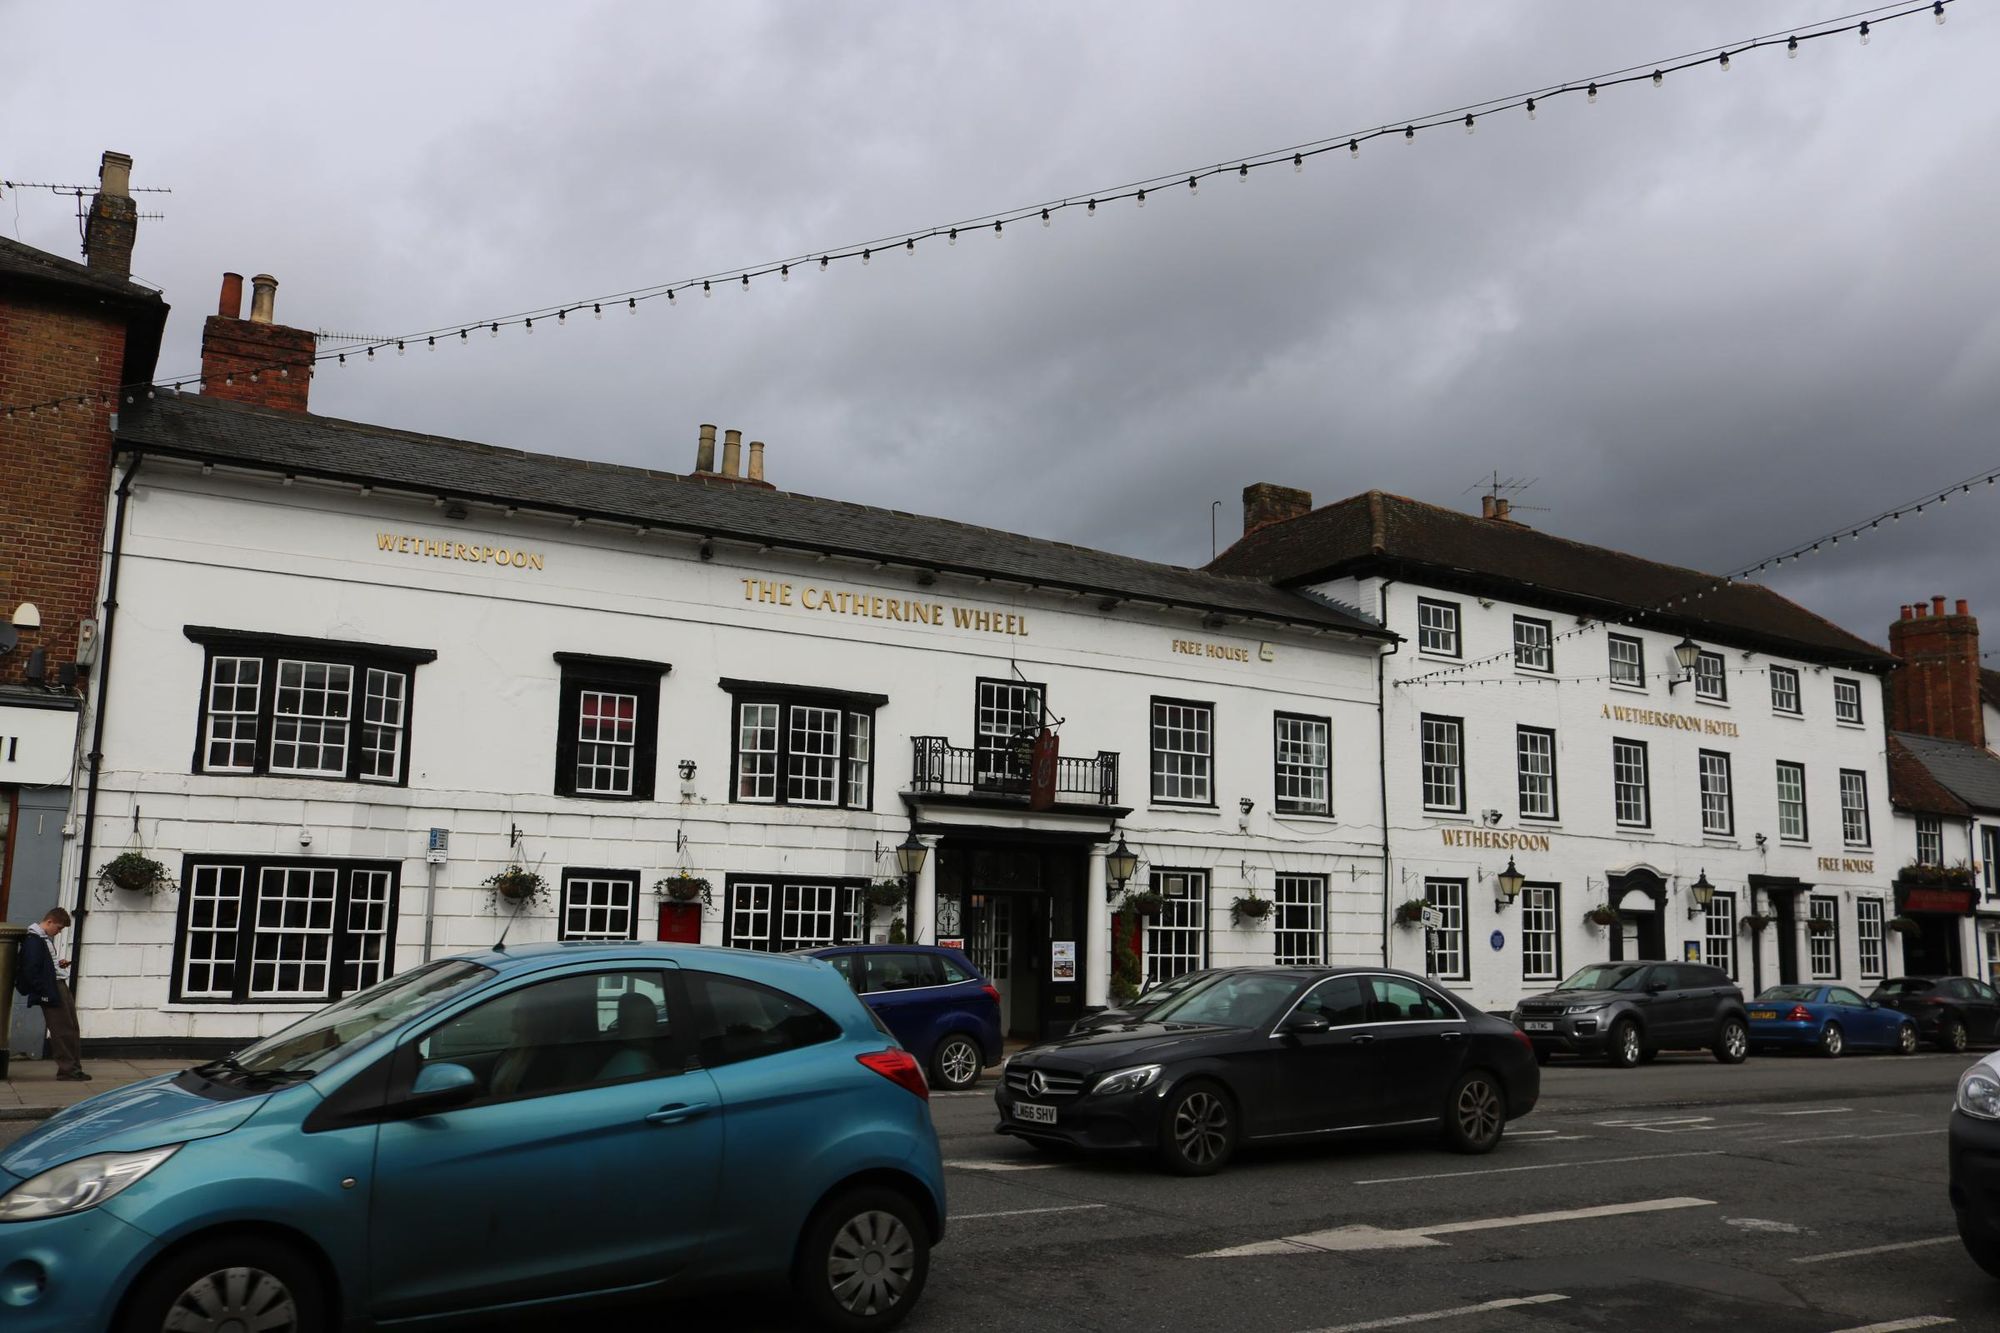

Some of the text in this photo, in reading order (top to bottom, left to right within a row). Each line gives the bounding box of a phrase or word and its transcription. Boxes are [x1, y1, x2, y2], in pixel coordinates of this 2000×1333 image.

[376, 532, 545, 571] WETHERSPOON
[741, 578, 1029, 636] THE CATHERINE WHEEL
[1172, 639, 1249, 662] FREE HOUSE
[1600, 703, 1739, 738] A WETHERSPOON HOTEL
[1442, 829, 1550, 852] WETHERSPOON
[1818, 857, 1874, 874] FREE HOUSE
[1036, 1106, 1055, 1121] SHV
